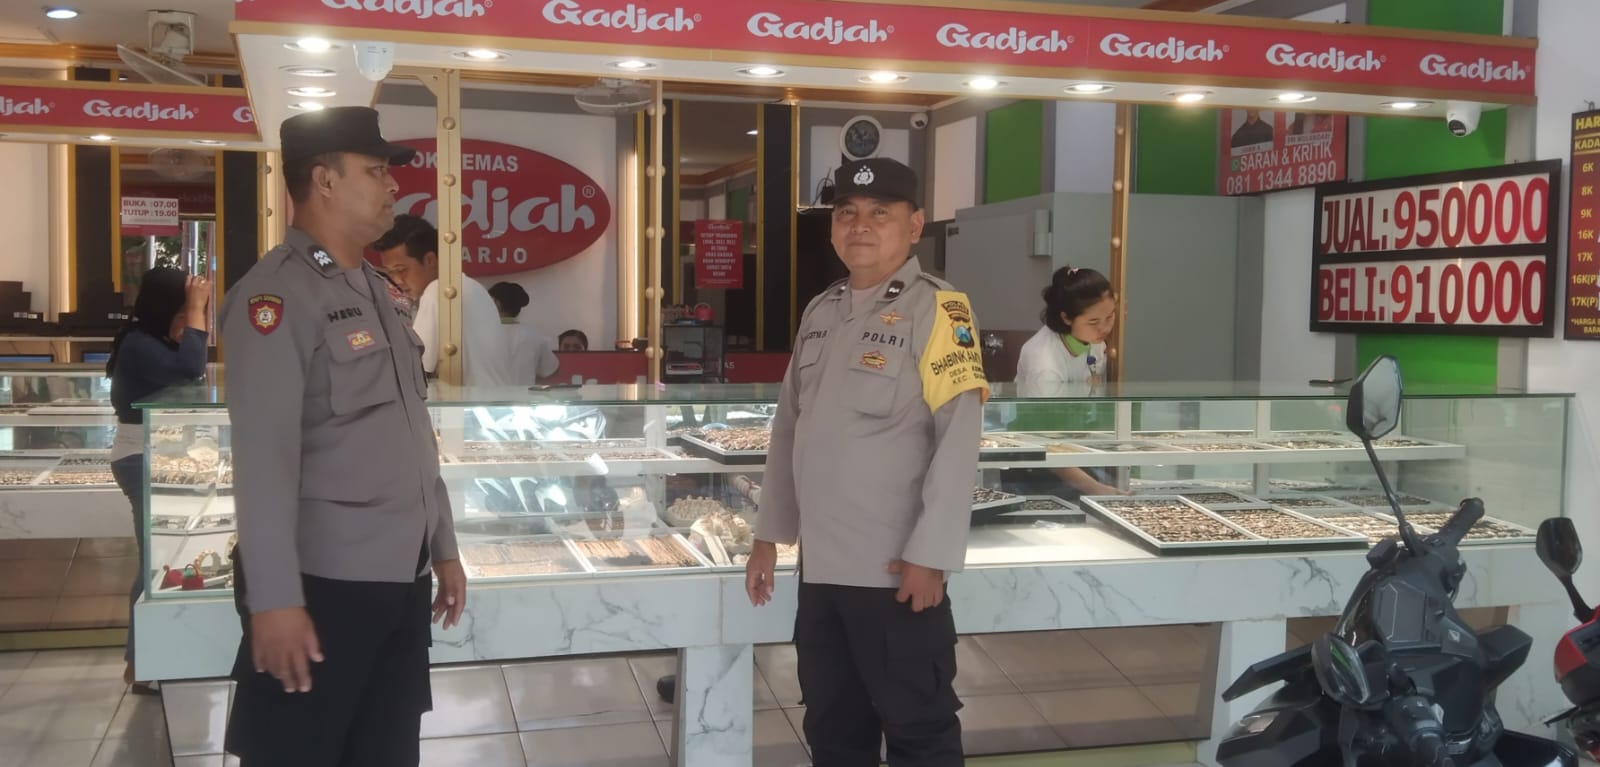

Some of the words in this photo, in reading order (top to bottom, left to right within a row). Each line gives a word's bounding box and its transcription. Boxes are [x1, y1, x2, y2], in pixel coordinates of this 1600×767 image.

[542, 0, 695, 33] Gadjah
[747, 12, 888, 45] Gadjah
[936, 23, 1068, 54] Gadjah
[1100, 33, 1224, 63] Gadjah
[1265, 43, 1381, 73] Gadjah
[1419, 54, 1527, 82] Gadjah
[83, 99, 195, 122] Gadjah
[463, 154, 519, 172] EMAS
[1240, 150, 1279, 172] SARAN
[1281, 148, 1290, 165] &
[1292, 143, 1332, 164] KRITIK
[1582, 162, 1594, 173] 6K
[1226, 174, 1251, 195] 081
[1257, 167, 1292, 193] 1344
[1298, 160, 1337, 186] 8890
[1581, 185, 1593, 196] 8K
[1580, 208, 1593, 219] 9K
[1578, 229, 1594, 240] 16K
[1577, 251, 1593, 262] 17K
[862, 332, 904, 348] POLRI
